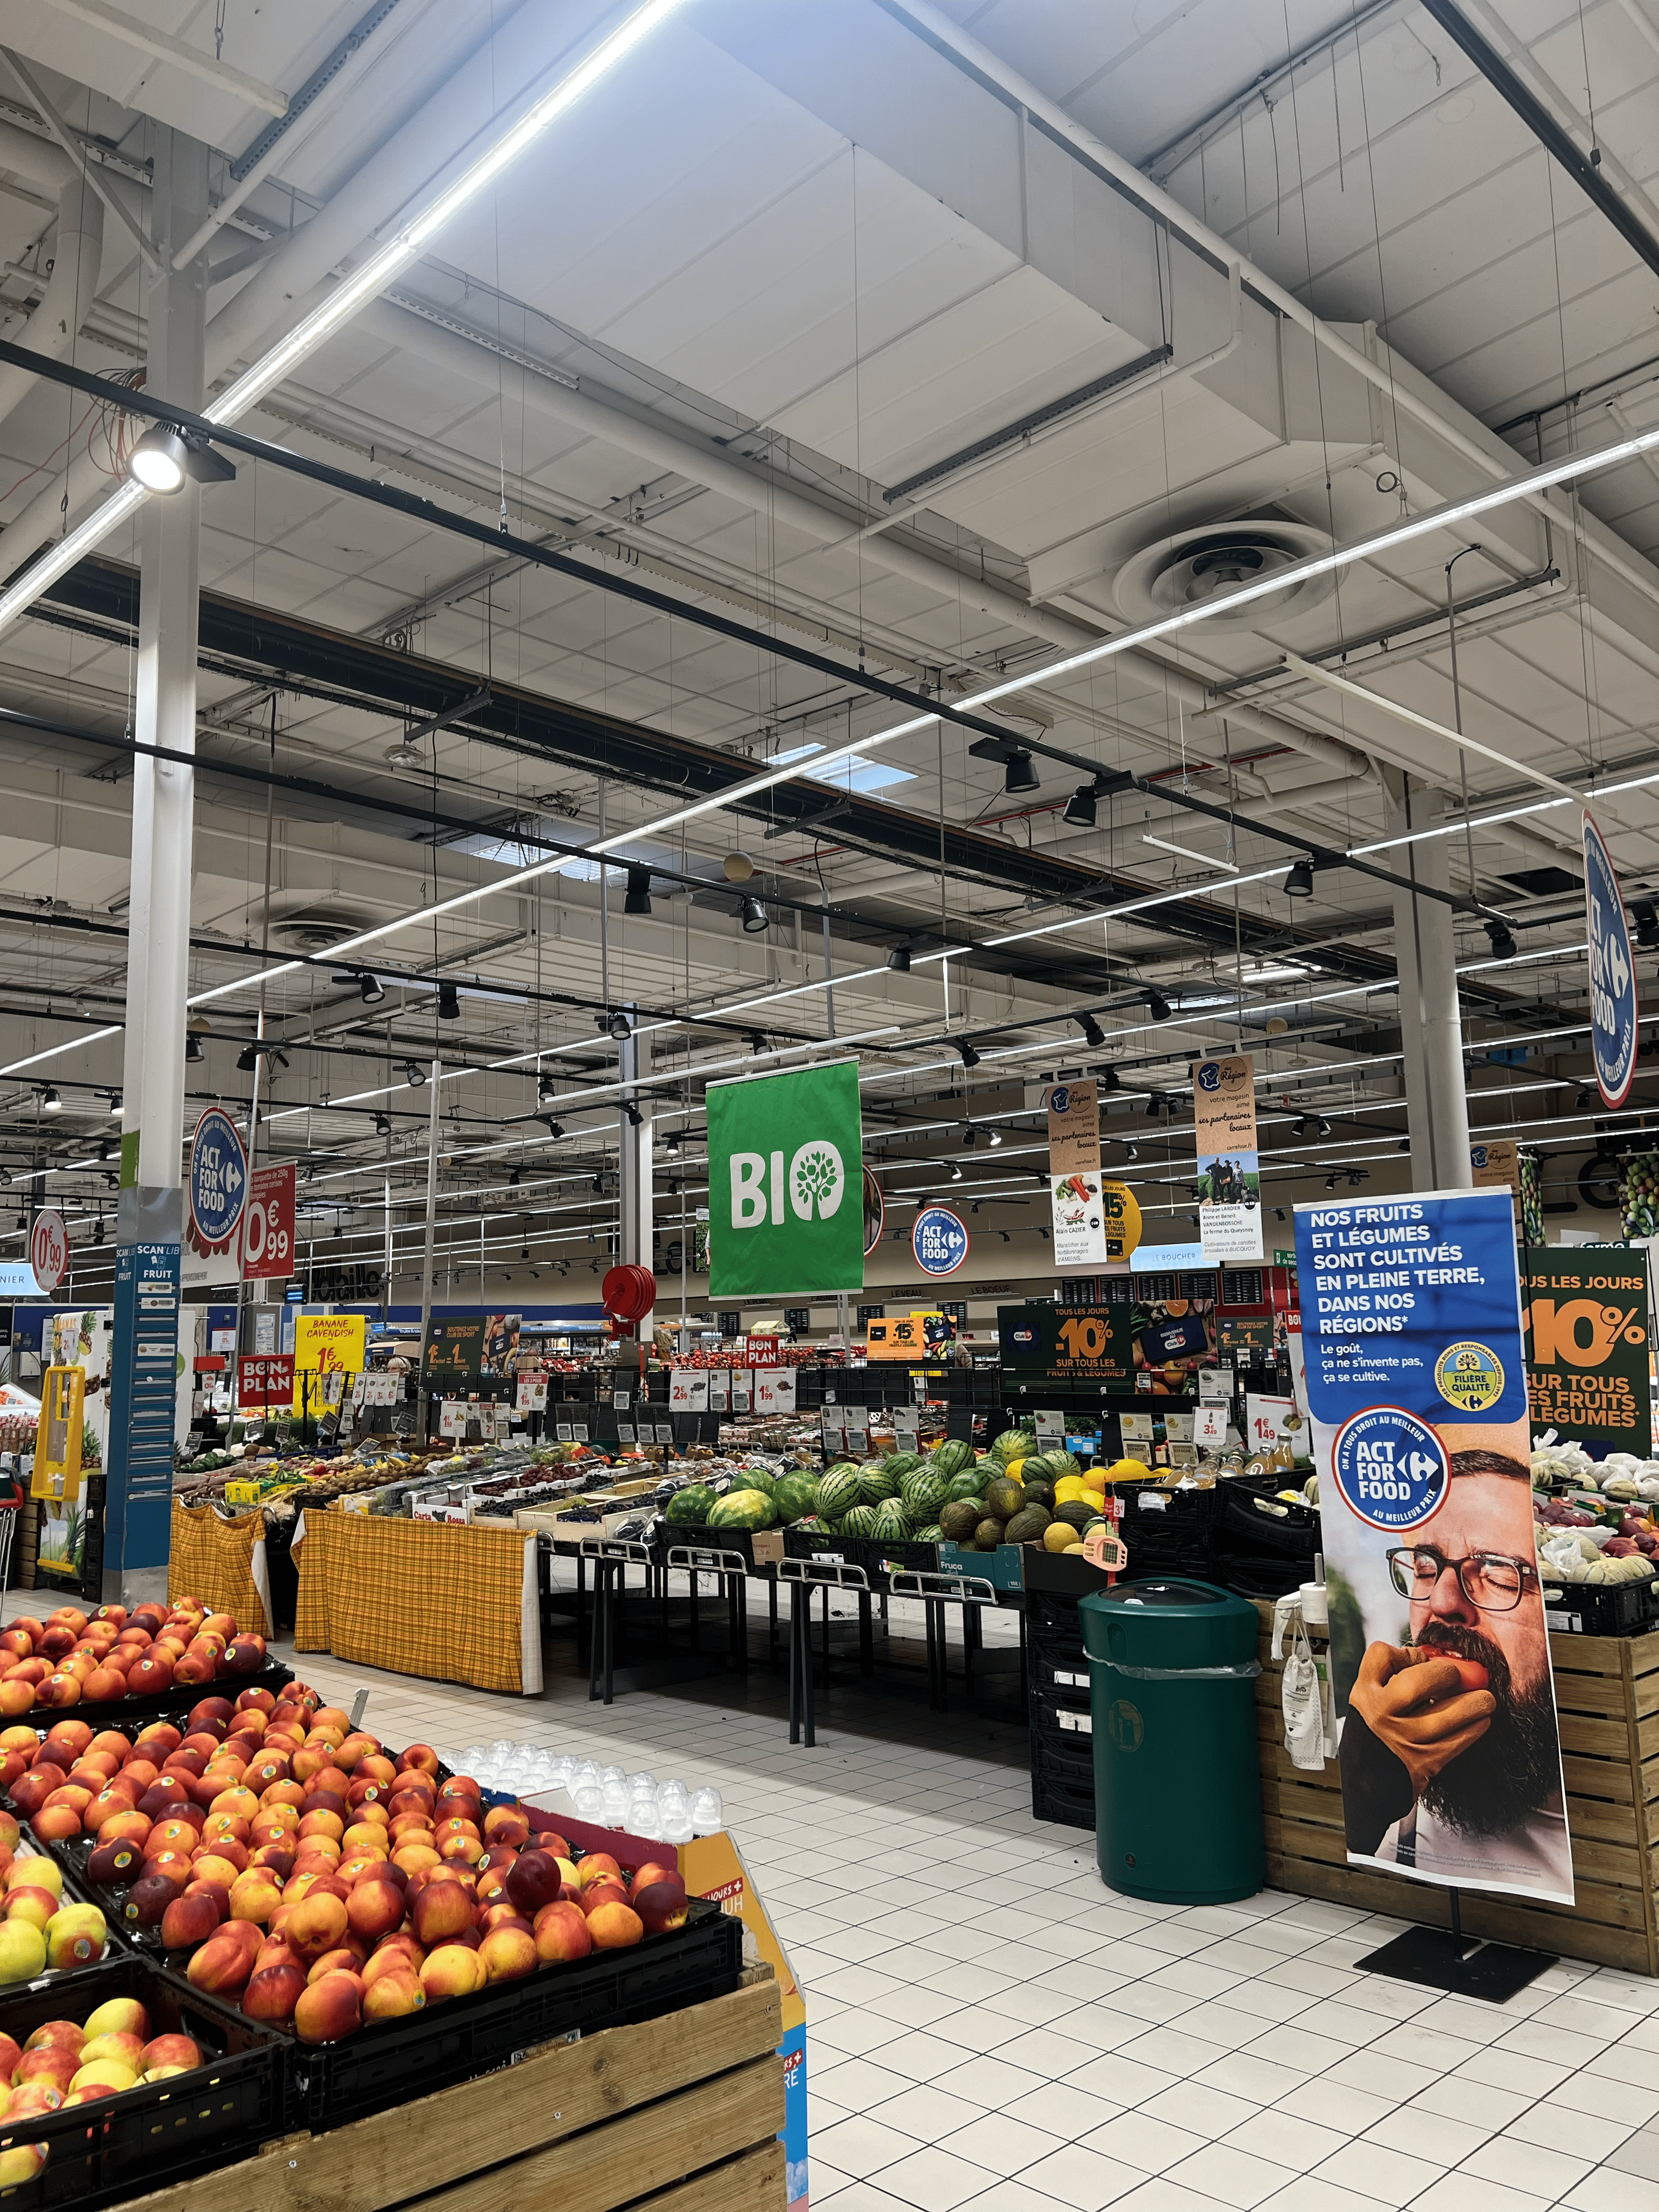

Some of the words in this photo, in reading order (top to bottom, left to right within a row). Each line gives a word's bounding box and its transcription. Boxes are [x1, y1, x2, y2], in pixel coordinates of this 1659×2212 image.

[1622, 1018, 1631, 1059] PRIX
[1220, 1070, 1246, 1084] Région
[1069, 1094, 1090, 1105] Région
[1210, 1113, 1251, 1127] partenaires
[1229, 1122, 1252, 1132] locaux
[1061, 1131, 1096, 1144] partenaires
[1077, 1140, 1096, 1148] locaux
[200, 1145, 219, 1170] ACT
[1488, 1152, 1510, 1163] Région
[200, 1167, 218, 1190] FOR
[730, 1141, 845, 1229] BIO
[198, 1188, 224, 1212] FOOD
[229, 1201, 239, 1223] PRIX
[1311, 1210, 1351, 1228] NOS
[1355, 1204, 1424, 1224] FRUITS
[922, 1226, 941, 1238] ACT
[1312, 1233, 1334, 1249] ET
[1338, 1224, 1431, 1247] LÉGUMES
[922, 1238, 941, 1248] FOR
[922, 1248, 949, 1259] FOOD
[1313, 1252, 1366, 1270] SONT
[1370, 1242, 1463, 1266] CULTIVÉS
[118, 1272, 132, 1281] FRUIT
[143, 1269, 173, 1278] FRUIT
[1316, 1276, 1341, 1291] EN
[1346, 1271, 1410, 1290] PLEINE
[1414, 1267, 1485, 1286] TERRE,
[1551, 1276, 1581, 1289] LES
[1585, 1277, 1644, 1290] JOURS
[1317, 1296, 1371, 1313] DANS
[1375, 1293, 1415, 1310] NOS
[313, 1320, 348, 1328] BANANE
[307, 1329, 354, 1338] CAVENDISH
[1056, 1317, 1114, 1358] -10%
[749, 1340, 771, 1351] BON
[1321, 1344, 1334, 1355] Le
[1336, 1342, 1363, 1356] goût,
[749, 1352, 776, 1364] PLAN
[1442, 1348, 1454, 1361] BONS
[1461, 1344, 1498, 1364] RESPONSABLES
[244, 1361, 283, 1376] BON
[1056, 1359, 1074, 1368] SUR
[1075, 1359, 1098, 1368] TOUS
[1099, 1359, 1116, 1367] LES
[1322, 1360, 1334, 1370] ça
[1336, 1359, 1350, 1368] ne
[1352, 1356, 1400, 1368] s'invente
[1402, 1357, 1424, 1369] pas,
[244, 1376, 290, 1392] PLAN
[1323, 1373, 1335, 1385] ça
[1338, 1374, 1350, 1382] se
[1352, 1370, 1390, 1382] cultive.
[1454, 1374, 1487, 1383] FILIÈRE
[1567, 1375, 1630, 1393] TOUS
[1452, 1383, 1491, 1392] QUALITÉ
[1556, 1391, 1636, 1411] FRUITS
[1355, 1417, 1378, 1434] DROIT
[1379, 1416, 1390, 1424] AU
[1391, 1417, 1426, 1442] MEILLEUR
[1344, 1430, 1358, 1451] TOUS
[1356, 1441, 1395, 1462] ACT
[1342, 1458, 1350, 1470] ON
[1356, 1462, 1396, 1481] FOR
[1358, 1481, 1411, 1500] FOOD
[1372, 1509, 1384, 1519] AU
[1385, 1505, 1423, 1522] MEILLEUR
[1420, 1489, 1437, 1509] PRIX
[414, 1511, 431, 1521] Carta
[941, 1561, 963, 1570] Fruca
